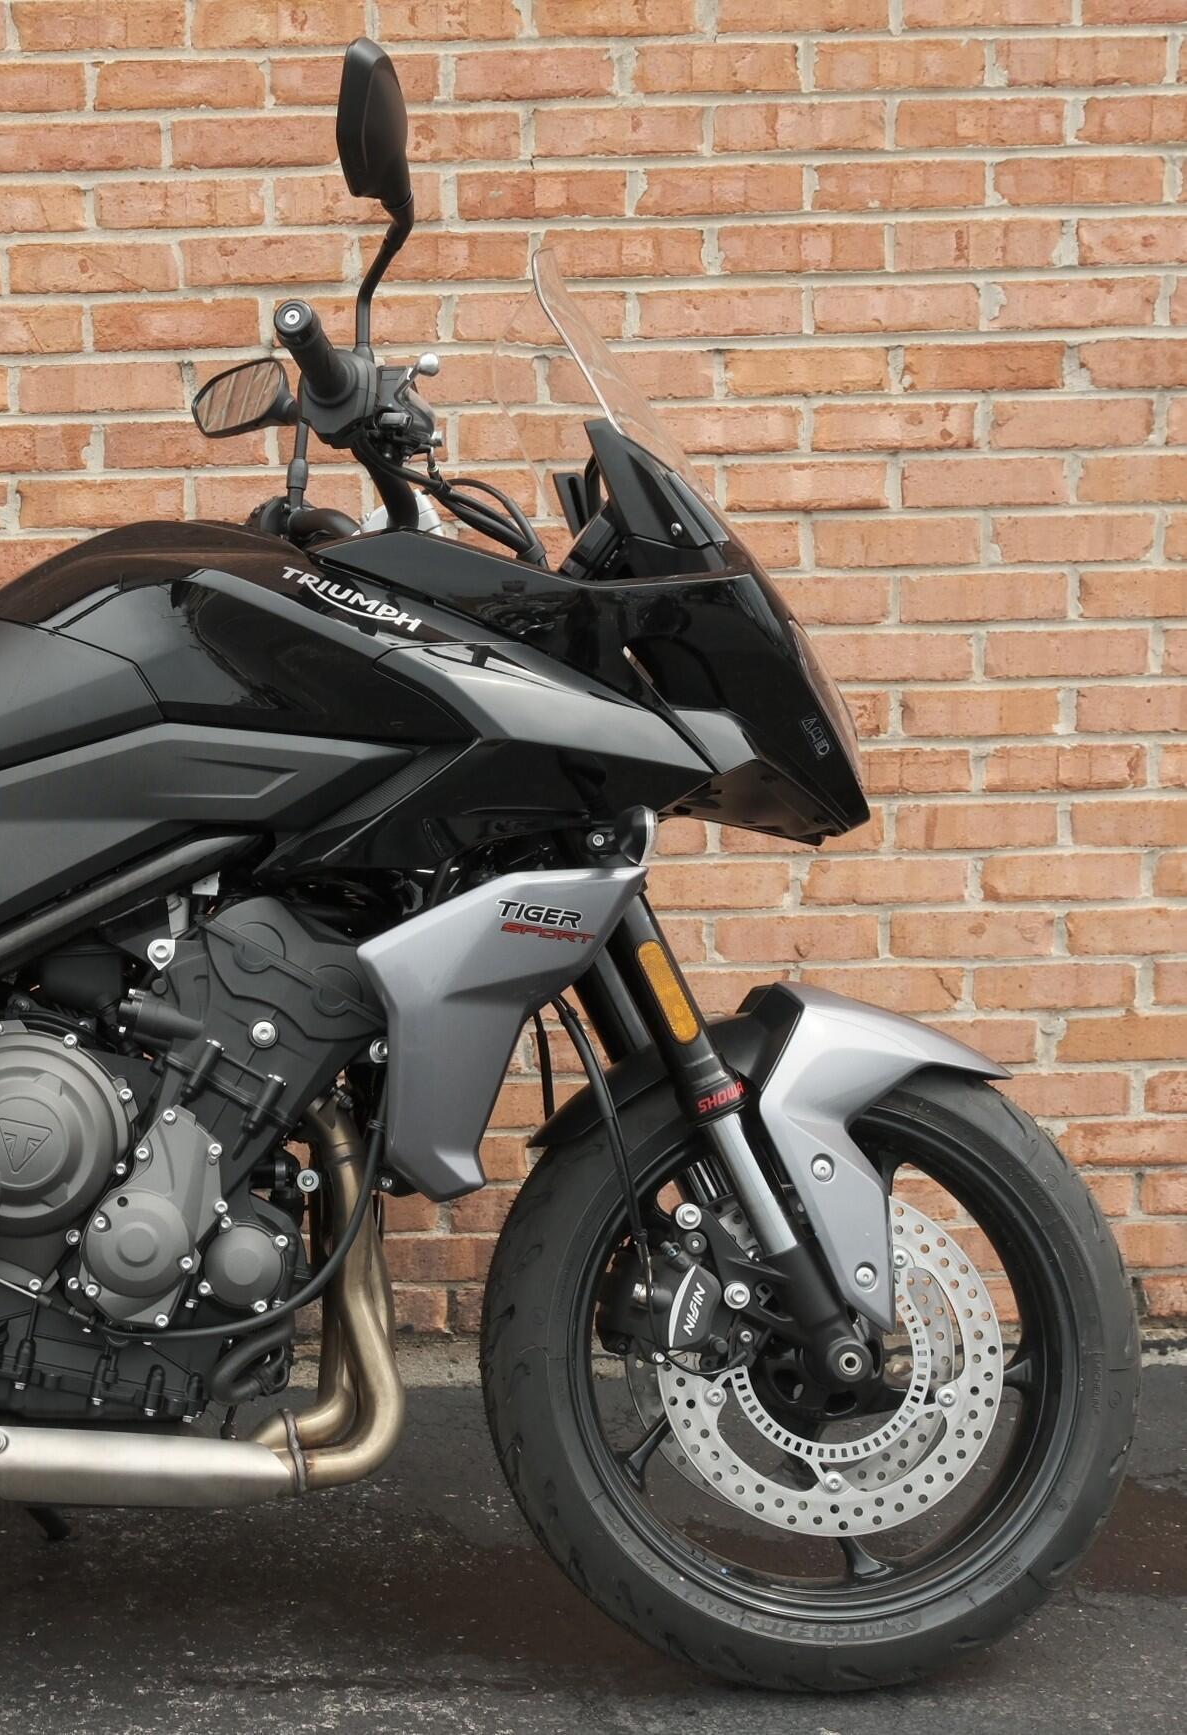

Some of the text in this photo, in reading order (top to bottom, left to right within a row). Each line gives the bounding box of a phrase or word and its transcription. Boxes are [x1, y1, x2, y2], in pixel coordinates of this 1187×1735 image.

[281, 566, 422, 632] TRIUMPH
[497, 898, 583, 929] TIGER
[500, 921, 597, 944] SPORT
[697, 1081, 744, 1114] SHOWA
[682, 1282, 706, 1337] NISSIN
